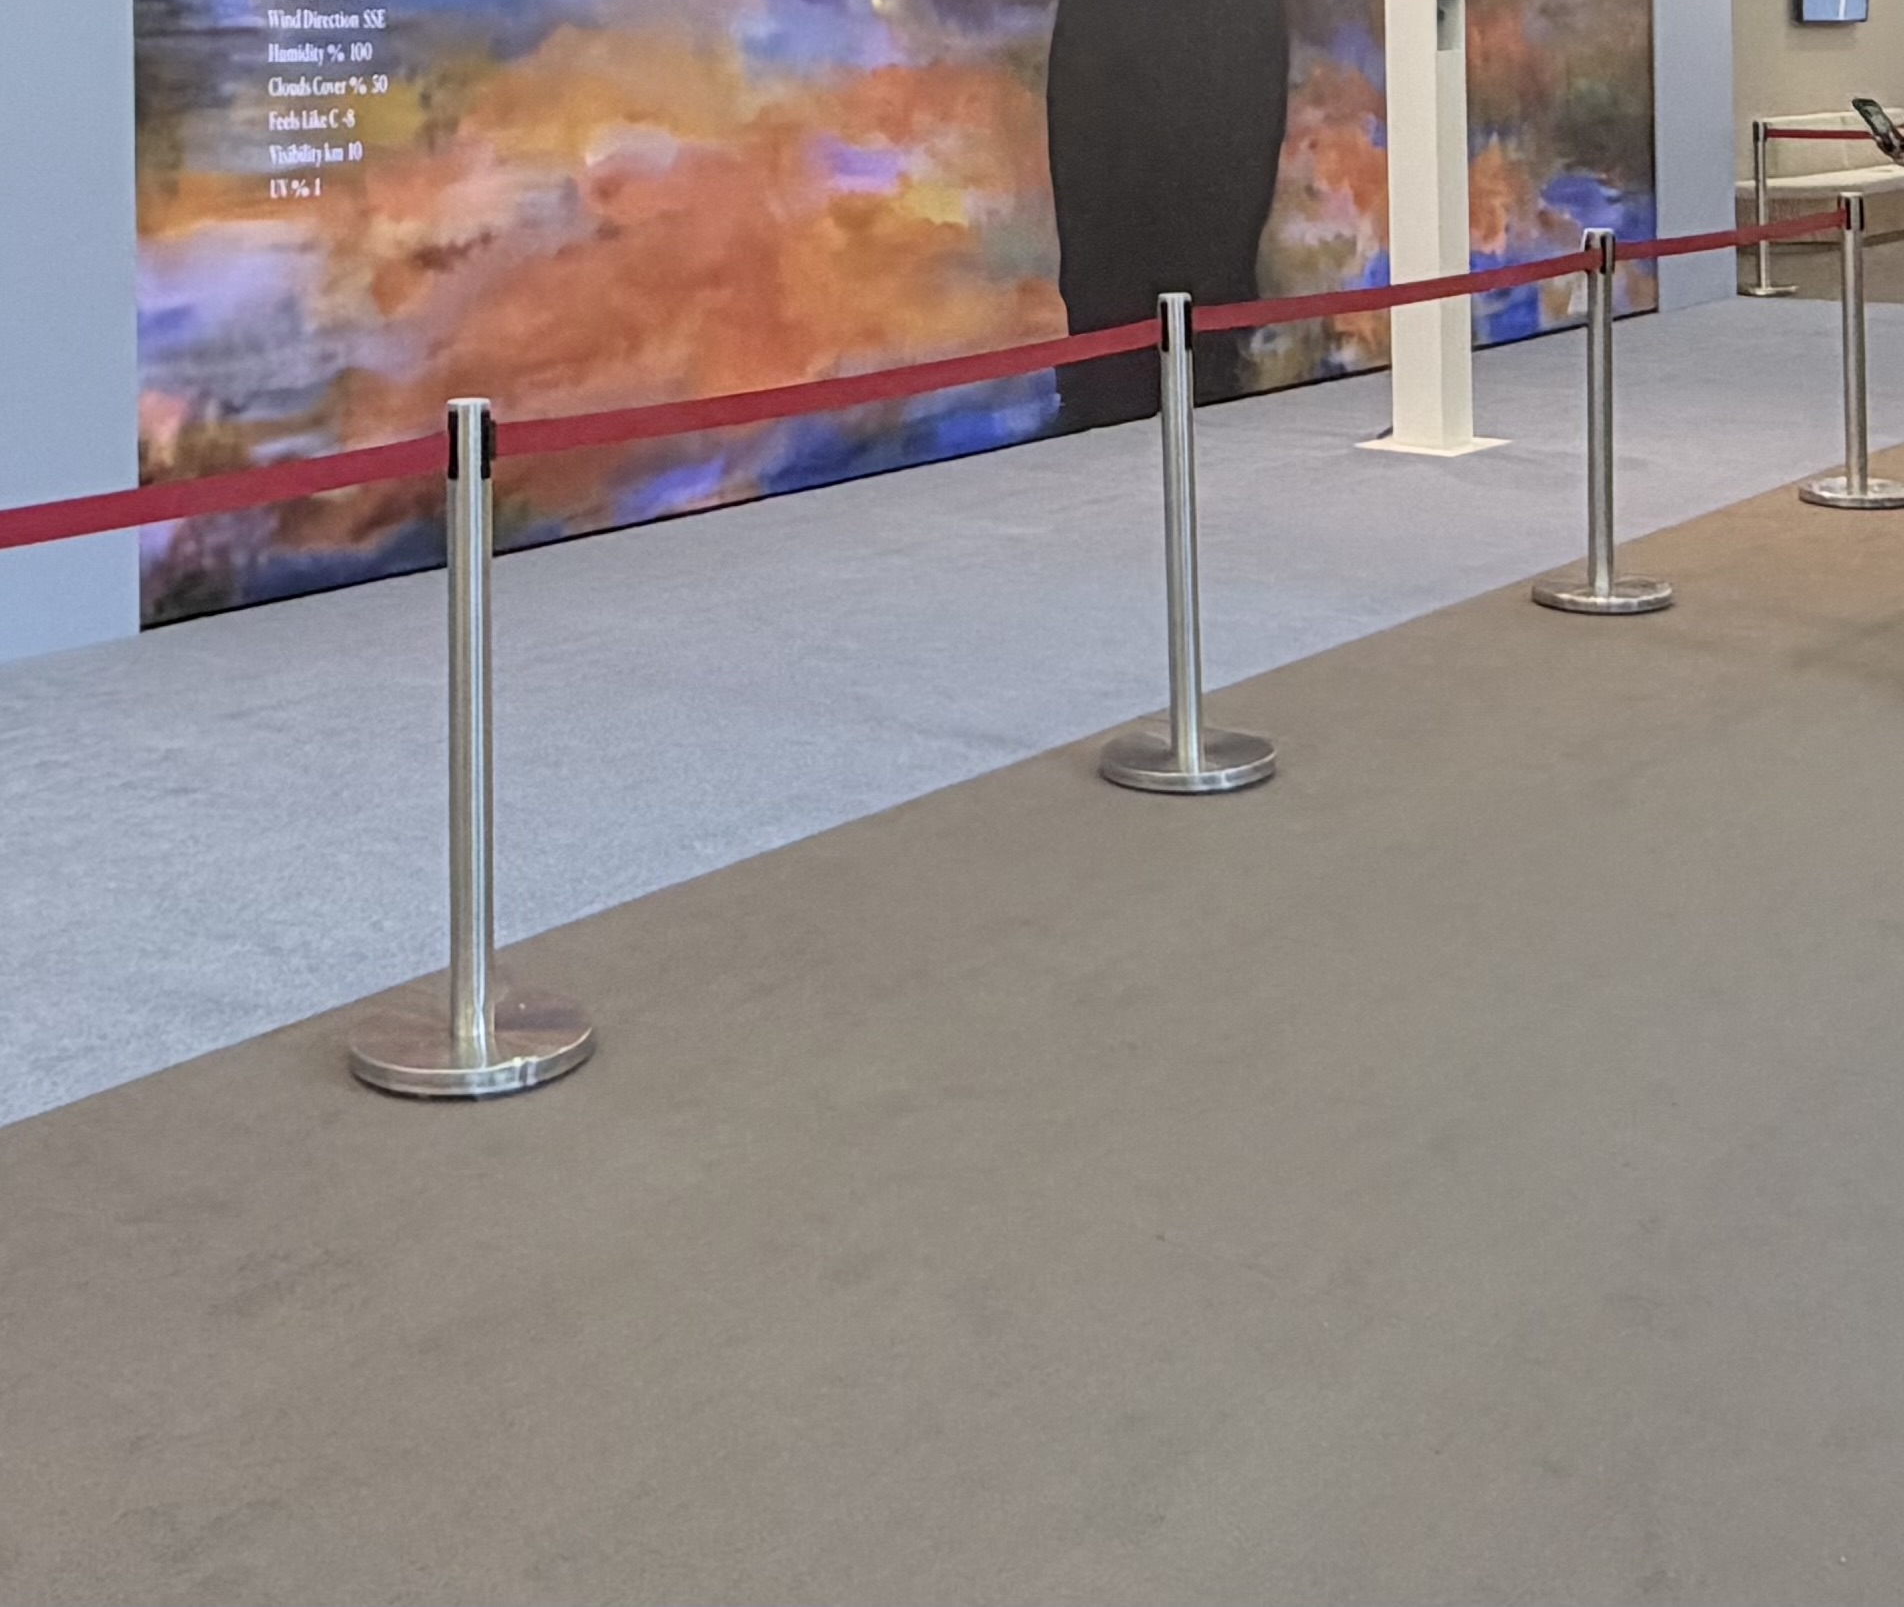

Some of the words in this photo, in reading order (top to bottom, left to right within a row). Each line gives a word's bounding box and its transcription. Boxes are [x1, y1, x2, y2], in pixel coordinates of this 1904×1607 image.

[268, 9, 301, 28] Wind
[304, 9, 359, 28] Direction
[363, 9, 386, 28] SSE
[268, 43, 324, 66] Humidity
[327, 44, 345, 62] %
[350, 42, 373, 61] 100
[268, 76, 312, 96] Clouds
[313, 76, 347, 95] Cover
[349, 76, 367, 94] %
[372, 74, 388, 93] 50
[268, 110, 300, 130] Feels
[302, 110, 327, 129] Like
[329, 109, 339, 128] C
[269, 144, 322, 167] Visibility
[324, 142, 343, 162] km
[348, 140, 363, 161] 10
[291, 179, 310, 197] %
